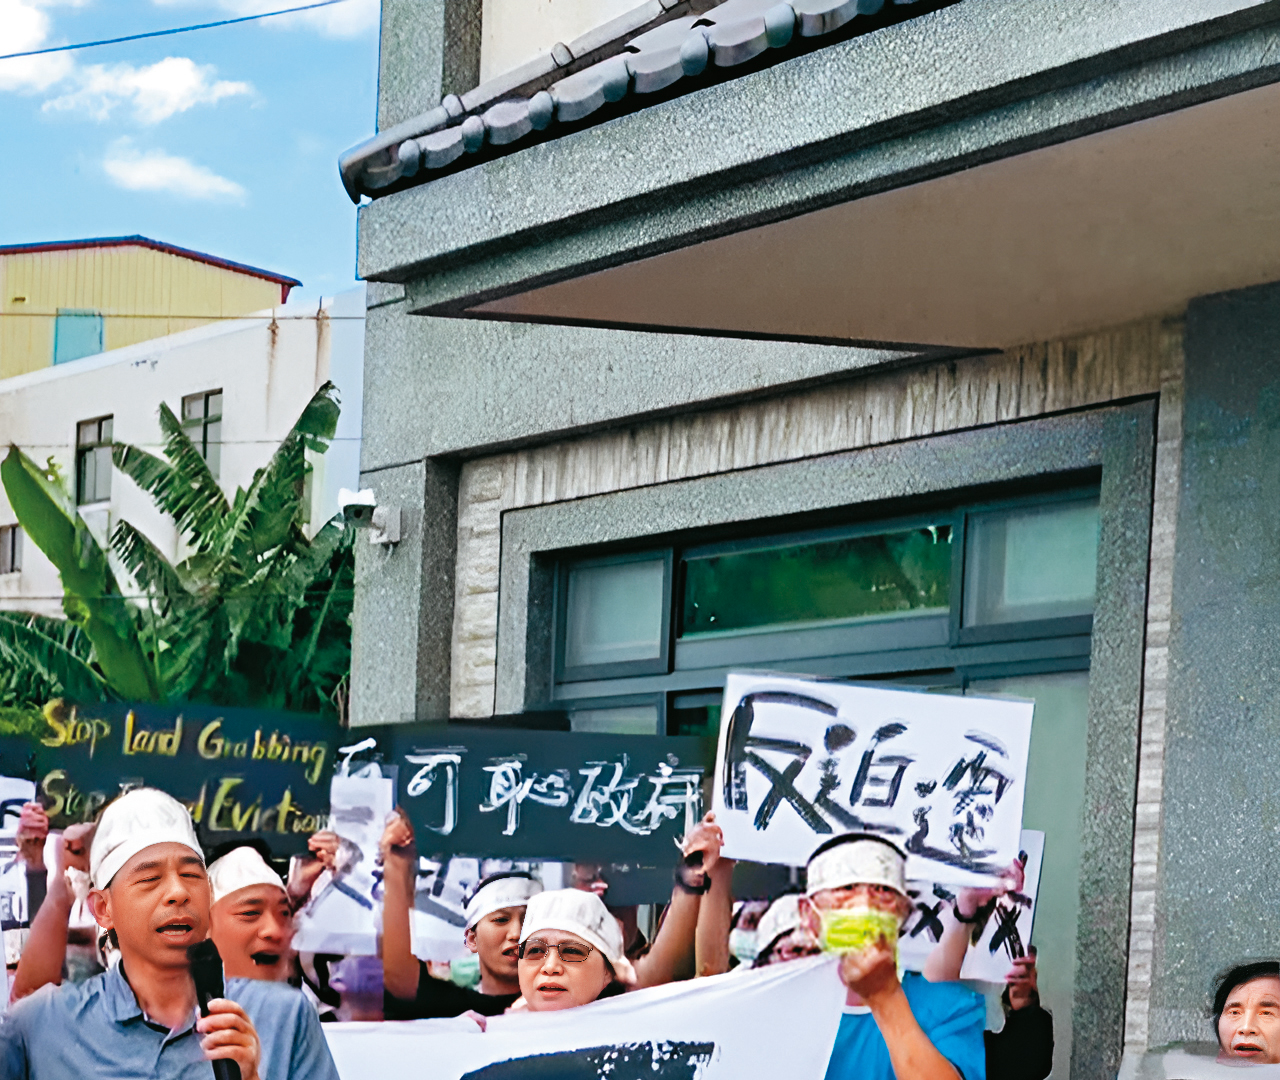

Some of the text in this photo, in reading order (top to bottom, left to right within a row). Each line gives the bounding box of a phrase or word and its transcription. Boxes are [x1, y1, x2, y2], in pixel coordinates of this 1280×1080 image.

[41, 698, 327, 785] Stop Land Grabbing
